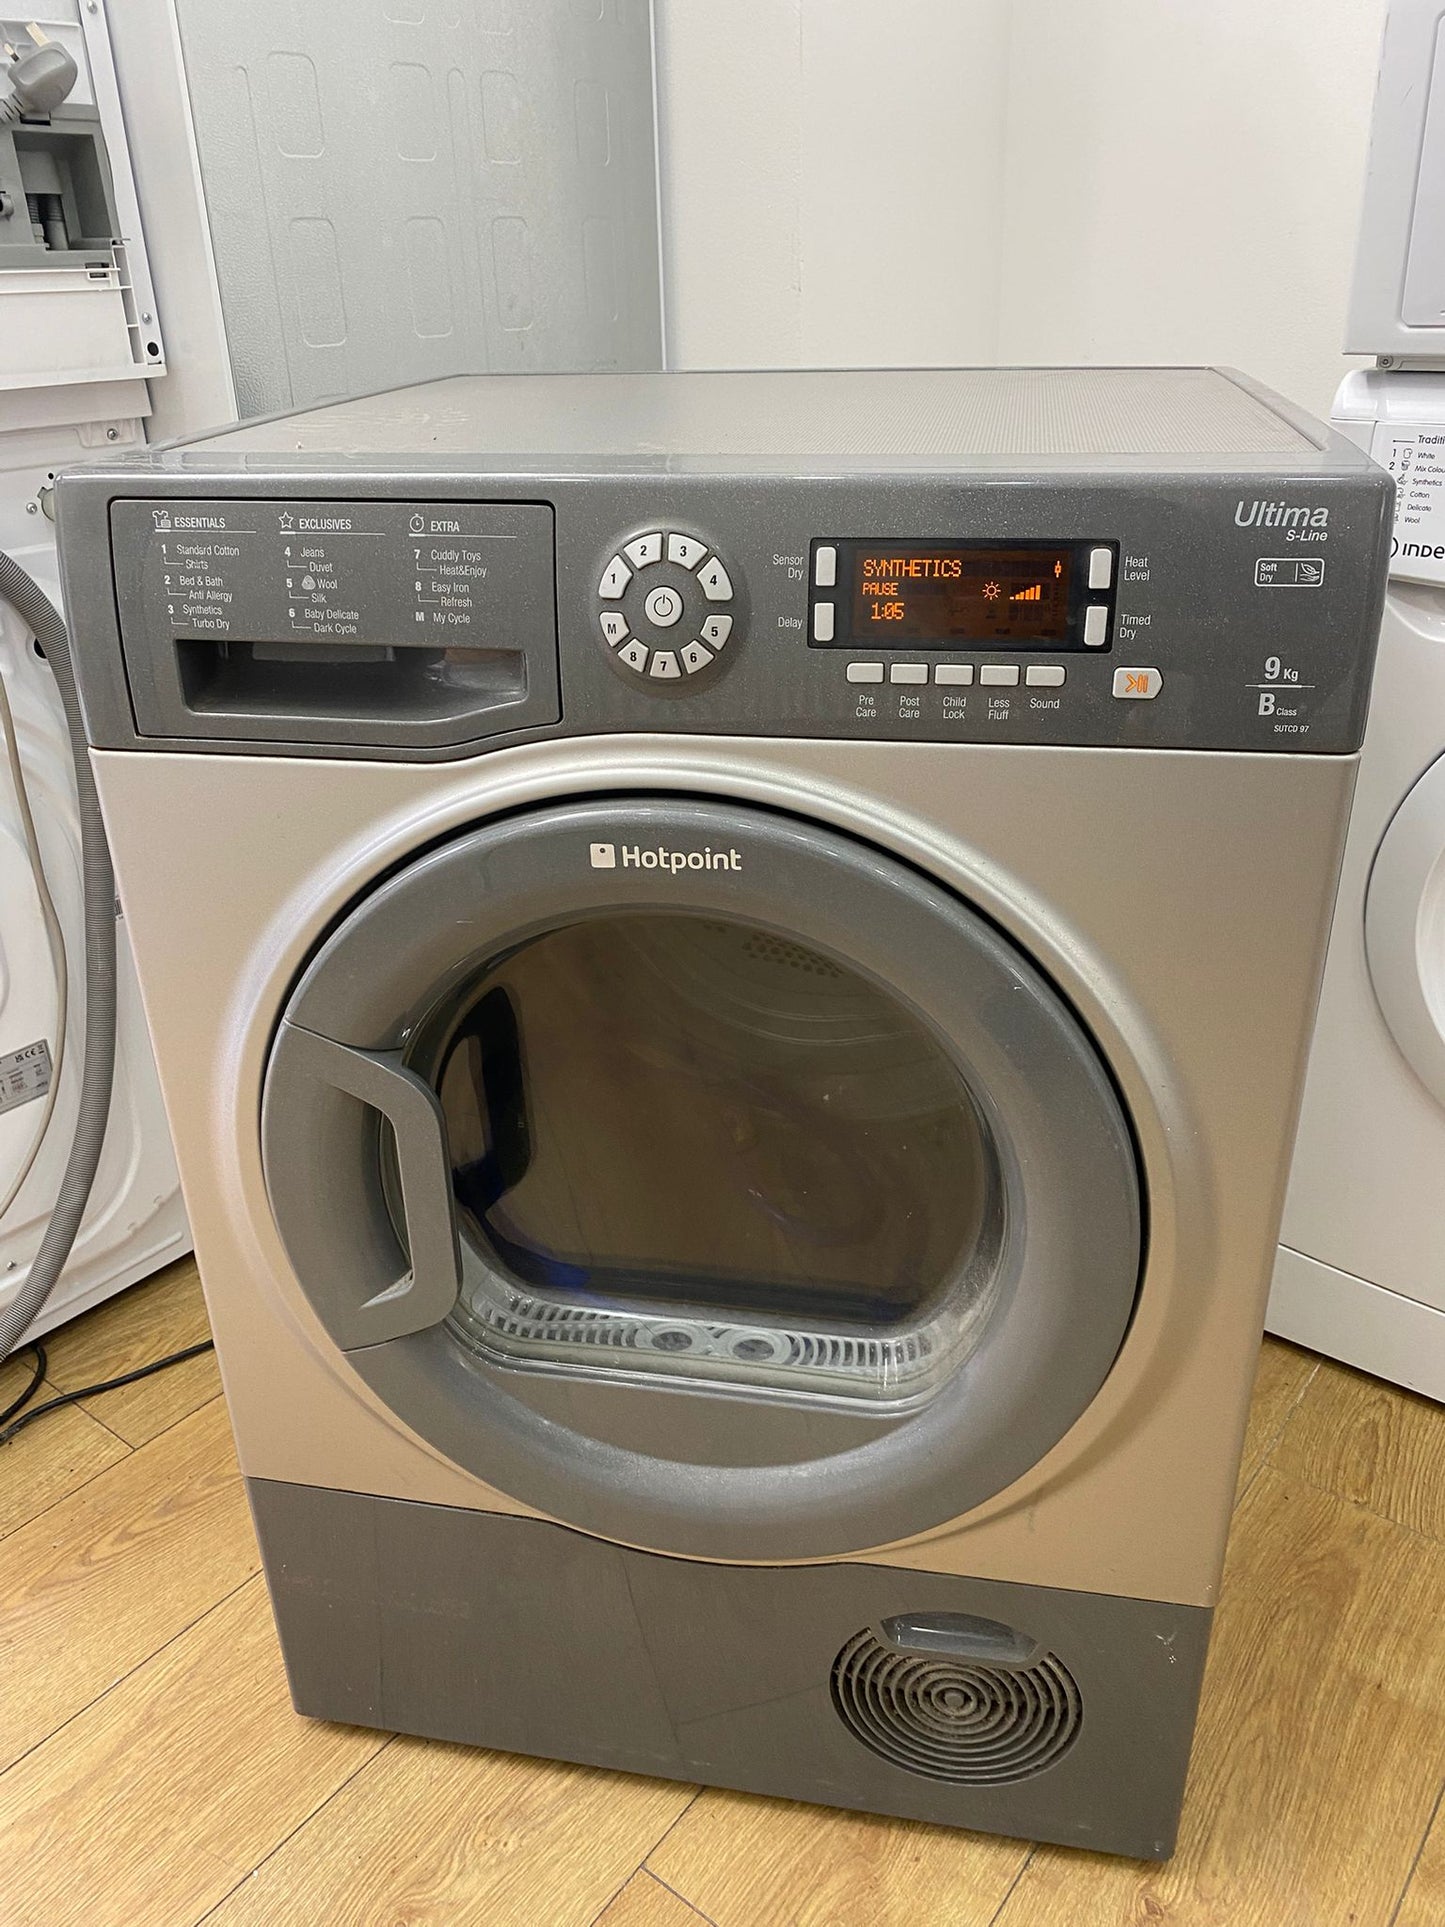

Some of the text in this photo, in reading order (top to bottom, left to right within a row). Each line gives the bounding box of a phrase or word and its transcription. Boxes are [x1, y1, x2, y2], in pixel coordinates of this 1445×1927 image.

[1393, 448, 1436, 460] 1 White
[1389, 461, 1395, 470] 2
[1414, 465, 1427, 473] Mix
[1412, 478, 1443, 487] Synthetics
[1409, 491, 1430, 499] Cotton
[1234, 500, 1329, 527] Ultima
[1407, 503, 1432, 512] Delicate
[174, 517, 226, 528] ESSENTIALS
[299, 519, 352, 530] EXCLUSIVES
[1404, 516, 1421, 524] Wool
[430, 521, 460, 532] EXTRA
[1286, 529, 1328, 541] S-Line
[161, 544, 240, 556] 1 Standard Cotton
[284, 547, 325, 558] 4 Jeans
[414, 549, 481, 563] 7 Cuddly Toys
[640, 545, 647, 556] 2
[680, 546, 687, 557] 3
[185, 559, 209, 569] Shirts
[772, 554, 804, 566] Sensor
[1125, 556, 1148, 568] Heat
[309, 561, 333, 573] Duvet
[440, 565, 487, 578] Heat&Enjoy
[863, 559, 962, 577] SYNTHETICS
[1260, 562, 1278, 572] Soft
[610, 573, 616, 584] 1
[788, 567, 803, 580] Dry
[1124, 569, 1150, 581] Level
[1259, 573, 1273, 583] Dry
[164, 575, 223, 586] 2 Bed & Bath
[286, 578, 338, 589] 5 Wool
[709, 575, 718, 586] 4
[415, 581, 470, 595] 8 Easy Iron
[862, 582, 899, 596] PAUSE
[189, 590, 233, 603] Anti Allergy
[311, 593, 327, 603] Silk
[440, 596, 473, 607] Refresh
[168, 604, 223, 616] 3 Synthetics
[289, 608, 359, 620] 6 Baby Delicate
[871, 602, 905, 620] 1:05
[415, 611, 471, 625] M My Cycle
[778, 617, 803, 630] Delay
[1121, 614, 1151, 626] Timed
[192, 618, 230, 631] Turbo Dry
[313, 622, 357, 635] Dark Cycle
[607, 623, 617, 634] M
[711, 626, 719, 637] 5
[1119, 627, 1137, 640] Dry
[630, 651, 637, 662] 8
[690, 652, 697, 663] 6
[660, 661, 667, 671] 7
[1264, 656, 1299, 682] 9 Kg
[859, 695, 874, 706] Pre
[899, 695, 920, 707] Post
[942, 696, 966, 708] Child
[988, 697, 1010, 709] Less
[1029, 698, 1060, 709] Sound
[1258, 692, 1297, 716] B Class
[855, 706, 877, 718] Care
[899, 707, 920, 719] Care
[943, 708, 965, 720] Lock
[988, 709, 1009, 720] Fluff
[1273, 724, 1310, 733] SUTCD 97
[622, 845, 742, 875] Hotpoint
